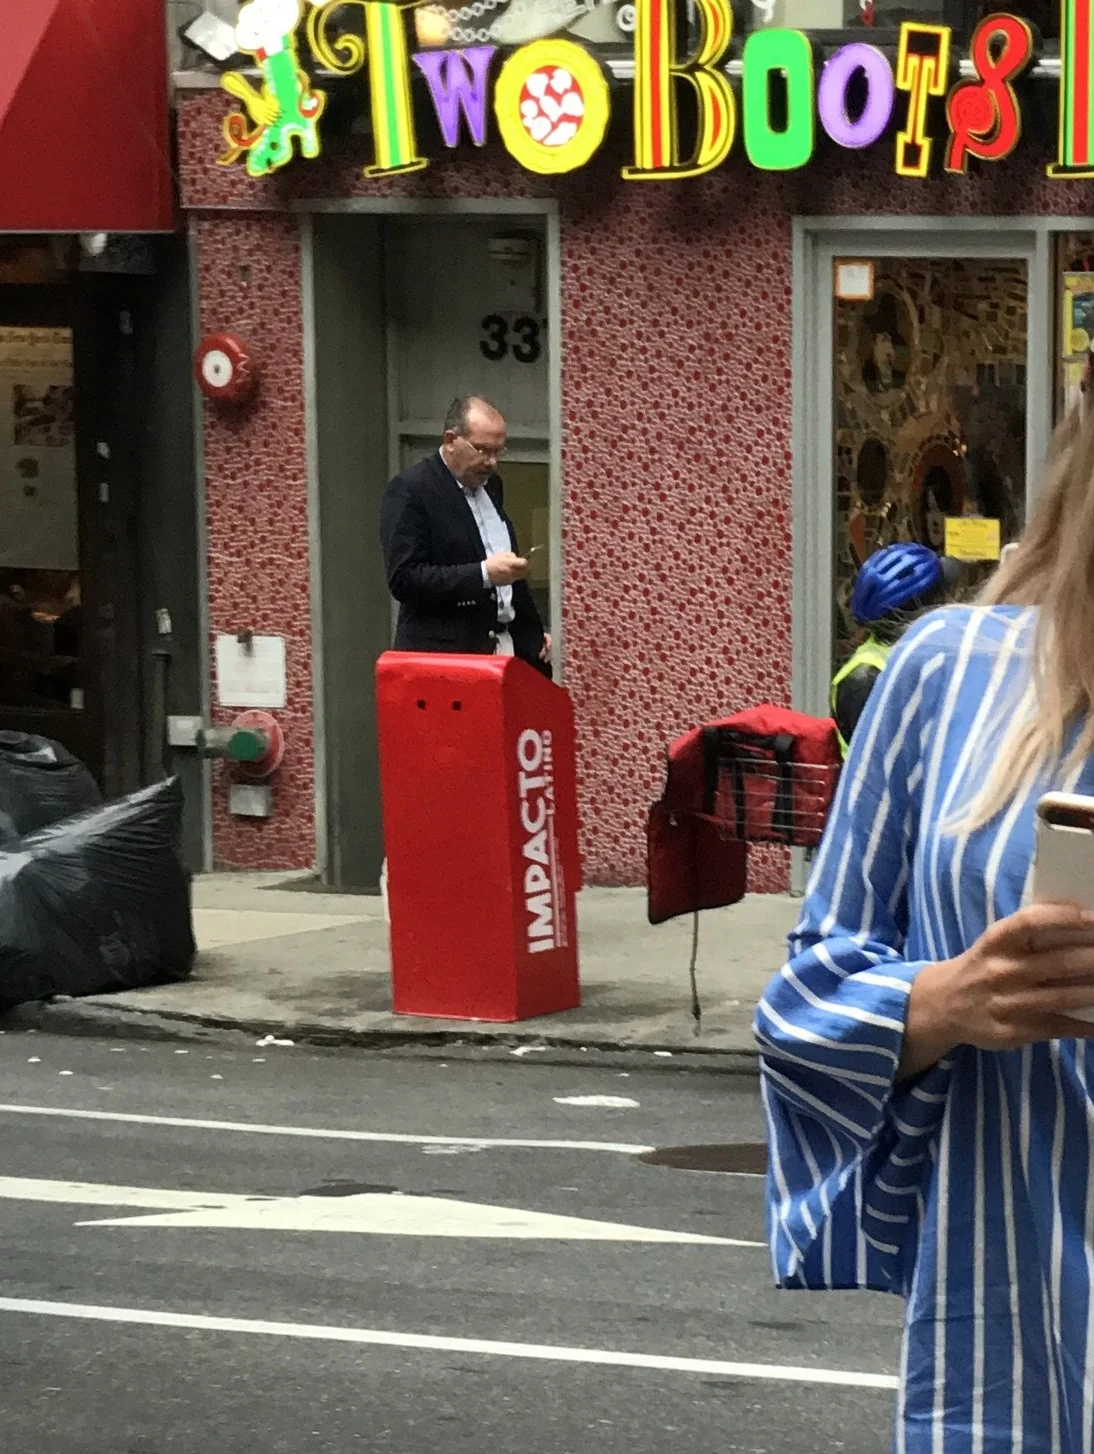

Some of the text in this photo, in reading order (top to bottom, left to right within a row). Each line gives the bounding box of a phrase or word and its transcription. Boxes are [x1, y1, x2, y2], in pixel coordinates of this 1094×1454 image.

[306, 0, 611, 178] TWO
[621, 0, 1033, 181] BOOTS
[480, 314, 549, 363] 33
[541, 729, 556, 816] LATINO
[517, 728, 555, 954] IMPACTO
